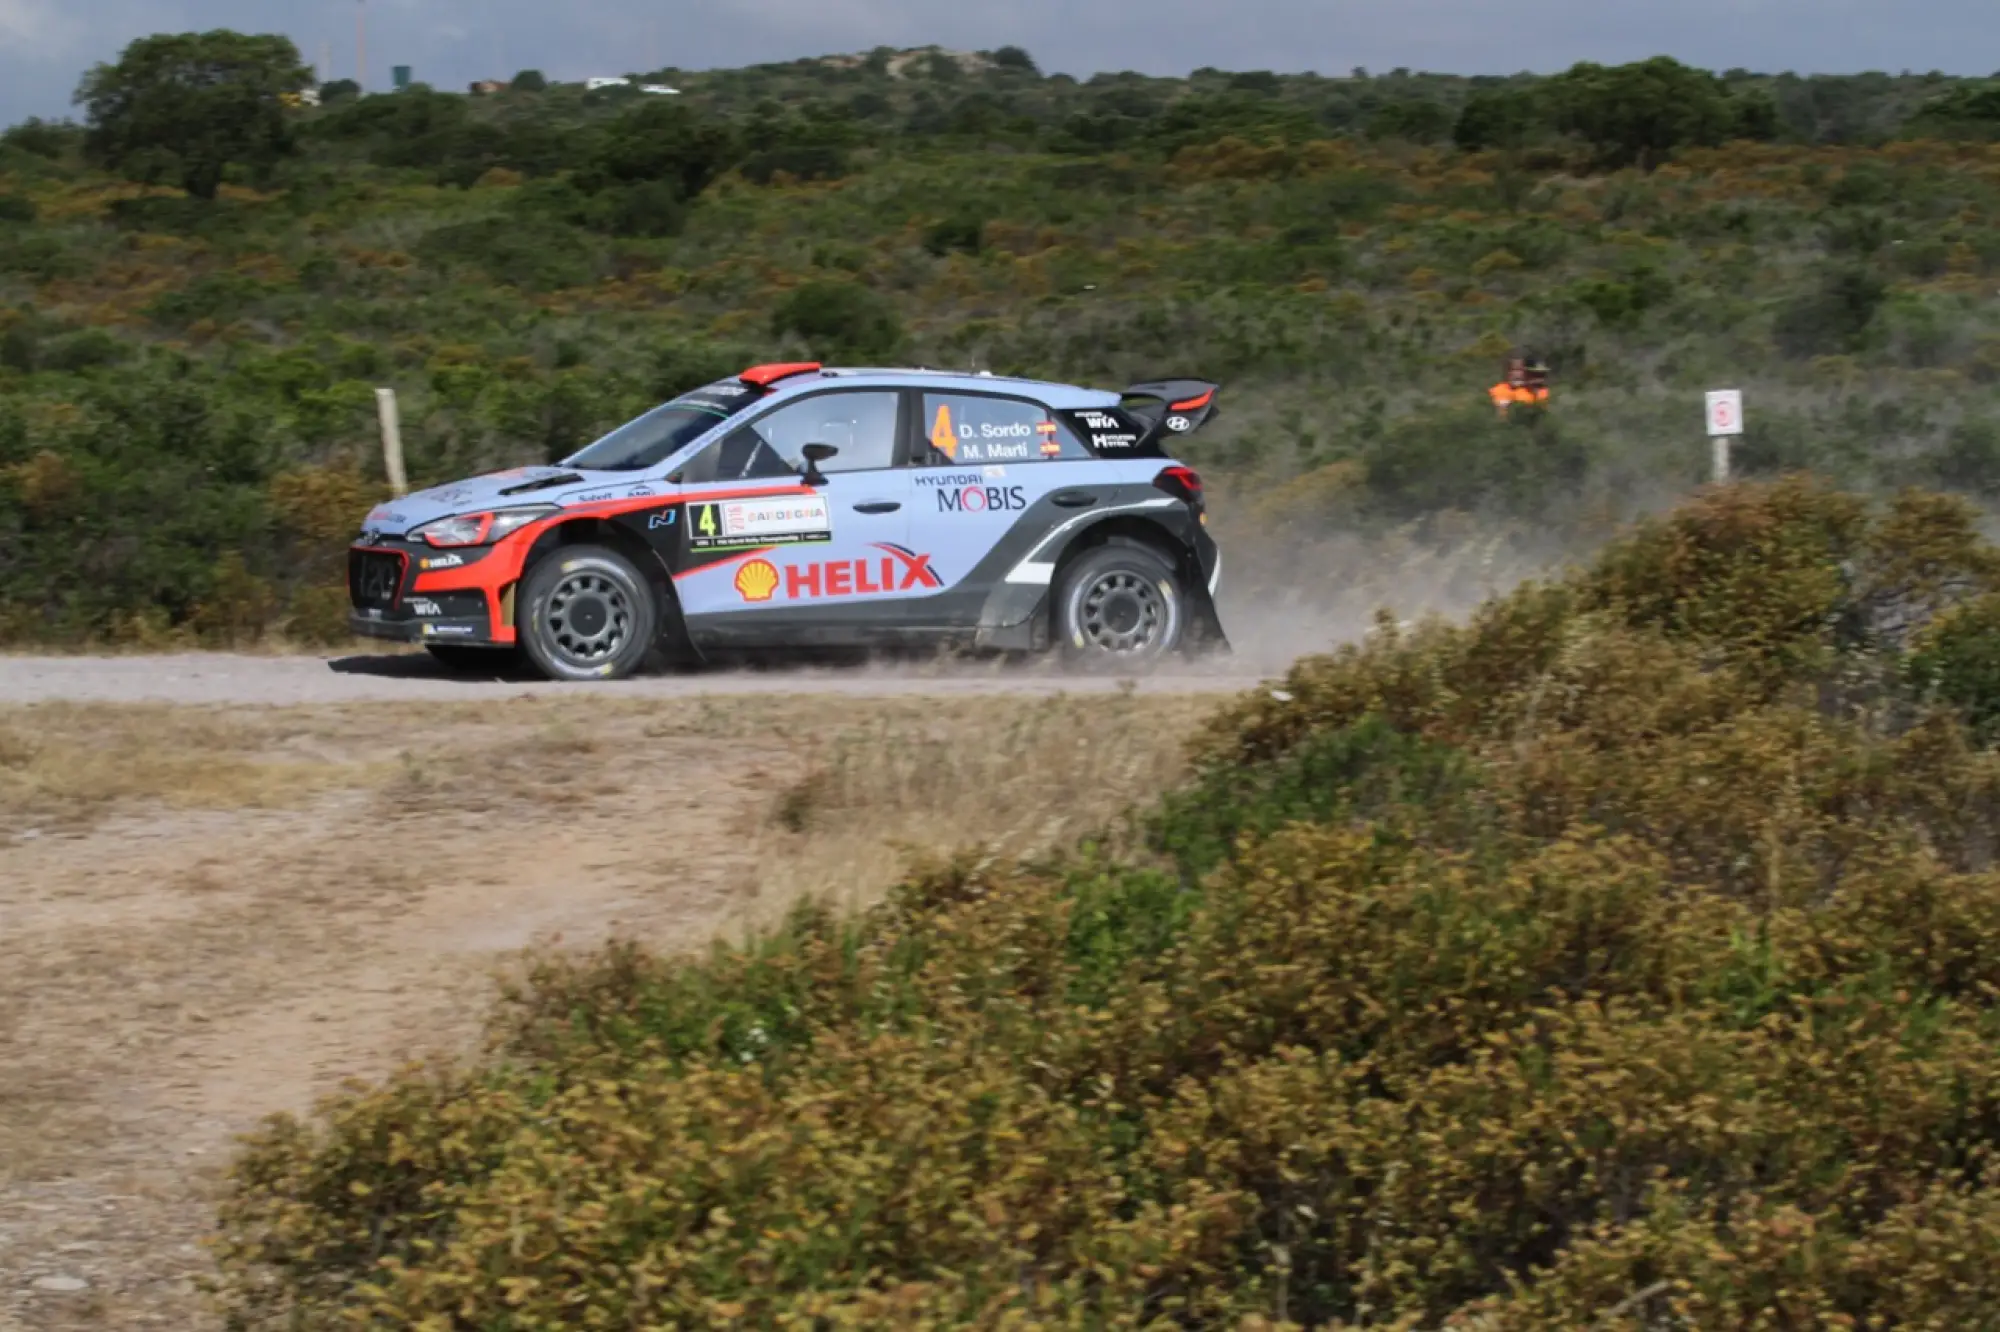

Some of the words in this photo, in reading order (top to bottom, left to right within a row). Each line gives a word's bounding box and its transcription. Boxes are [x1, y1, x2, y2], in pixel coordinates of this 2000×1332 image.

[931, 404, 958, 457] 4
[959, 424, 978, 438] D.
[981, 422, 1031, 438] Sordo
[963, 445, 983, 459] M.
[915, 474, 984, 486] HYUNDAI
[937, 486, 1026, 513] MOBIS
[699, 504, 716, 537] 4
[784, 542, 944, 599] HELIX
